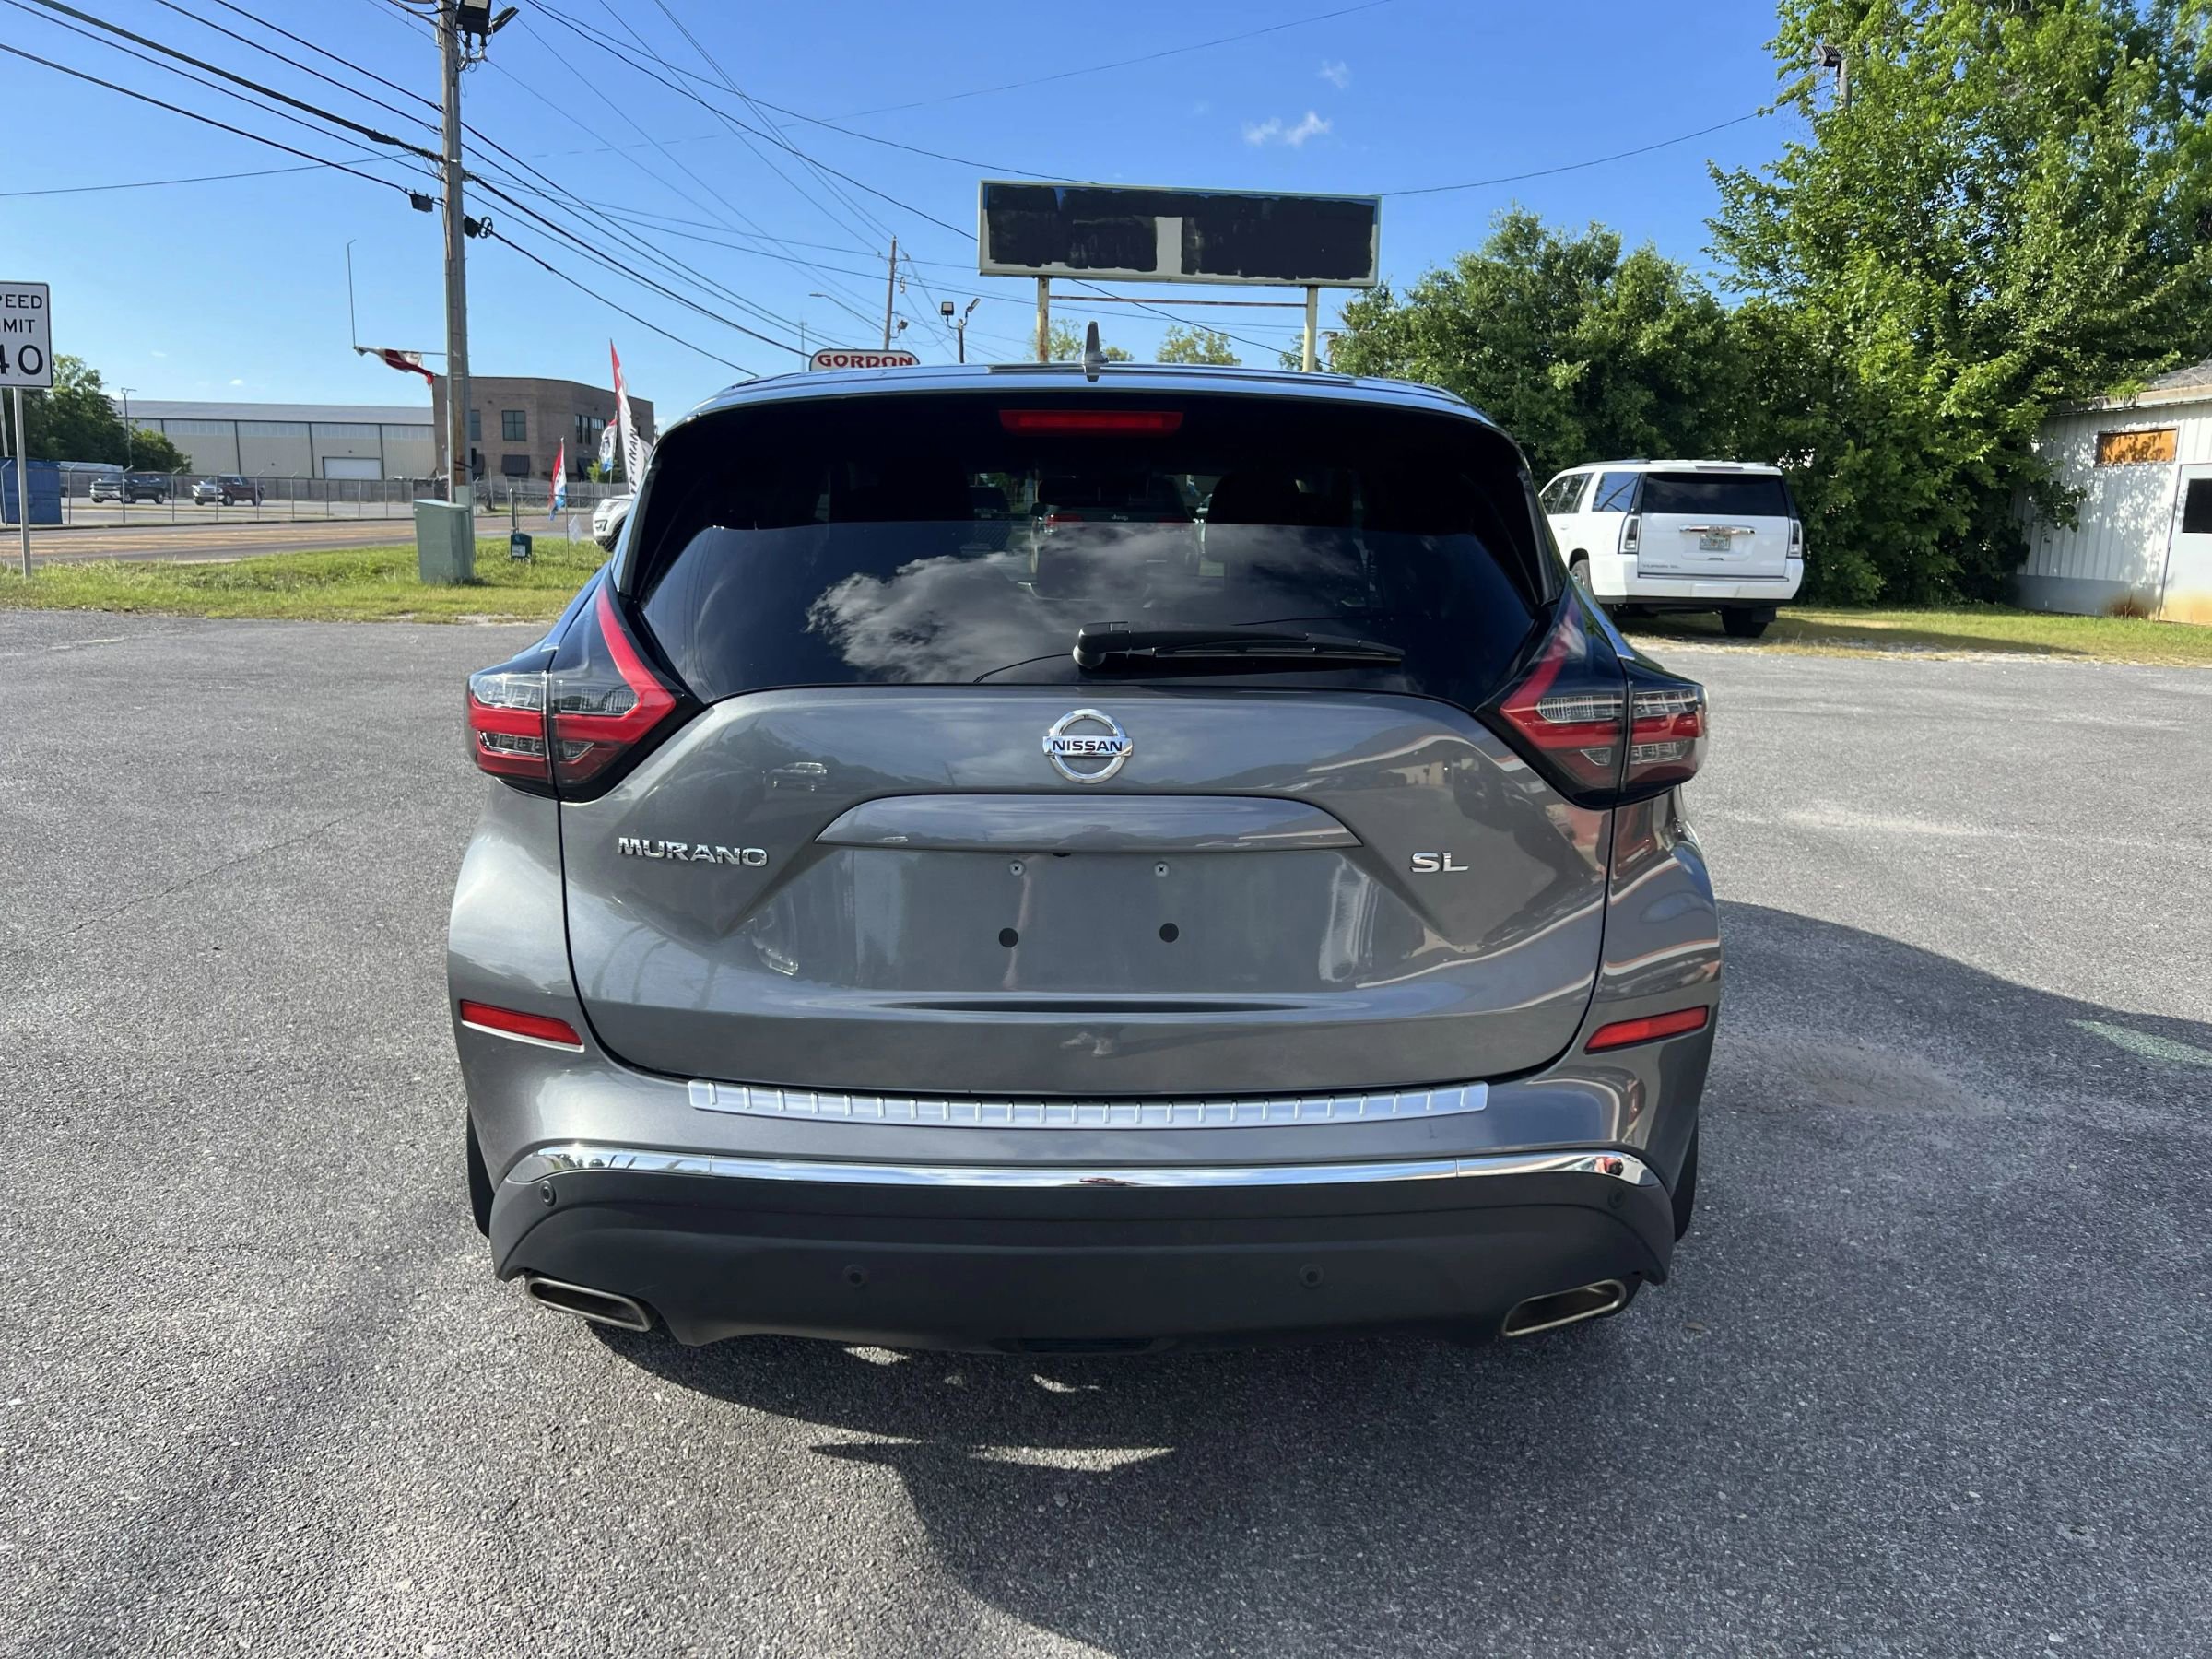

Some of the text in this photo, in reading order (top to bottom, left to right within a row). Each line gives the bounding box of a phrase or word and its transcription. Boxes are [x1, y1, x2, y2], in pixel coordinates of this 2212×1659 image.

[0, 294, 42, 309] EED
[818, 354, 912, 368] GORDON
[1053, 740, 1123, 752] NISSAN
[618, 837, 768, 867] MURANO
[1410, 852, 1469, 873] SL
